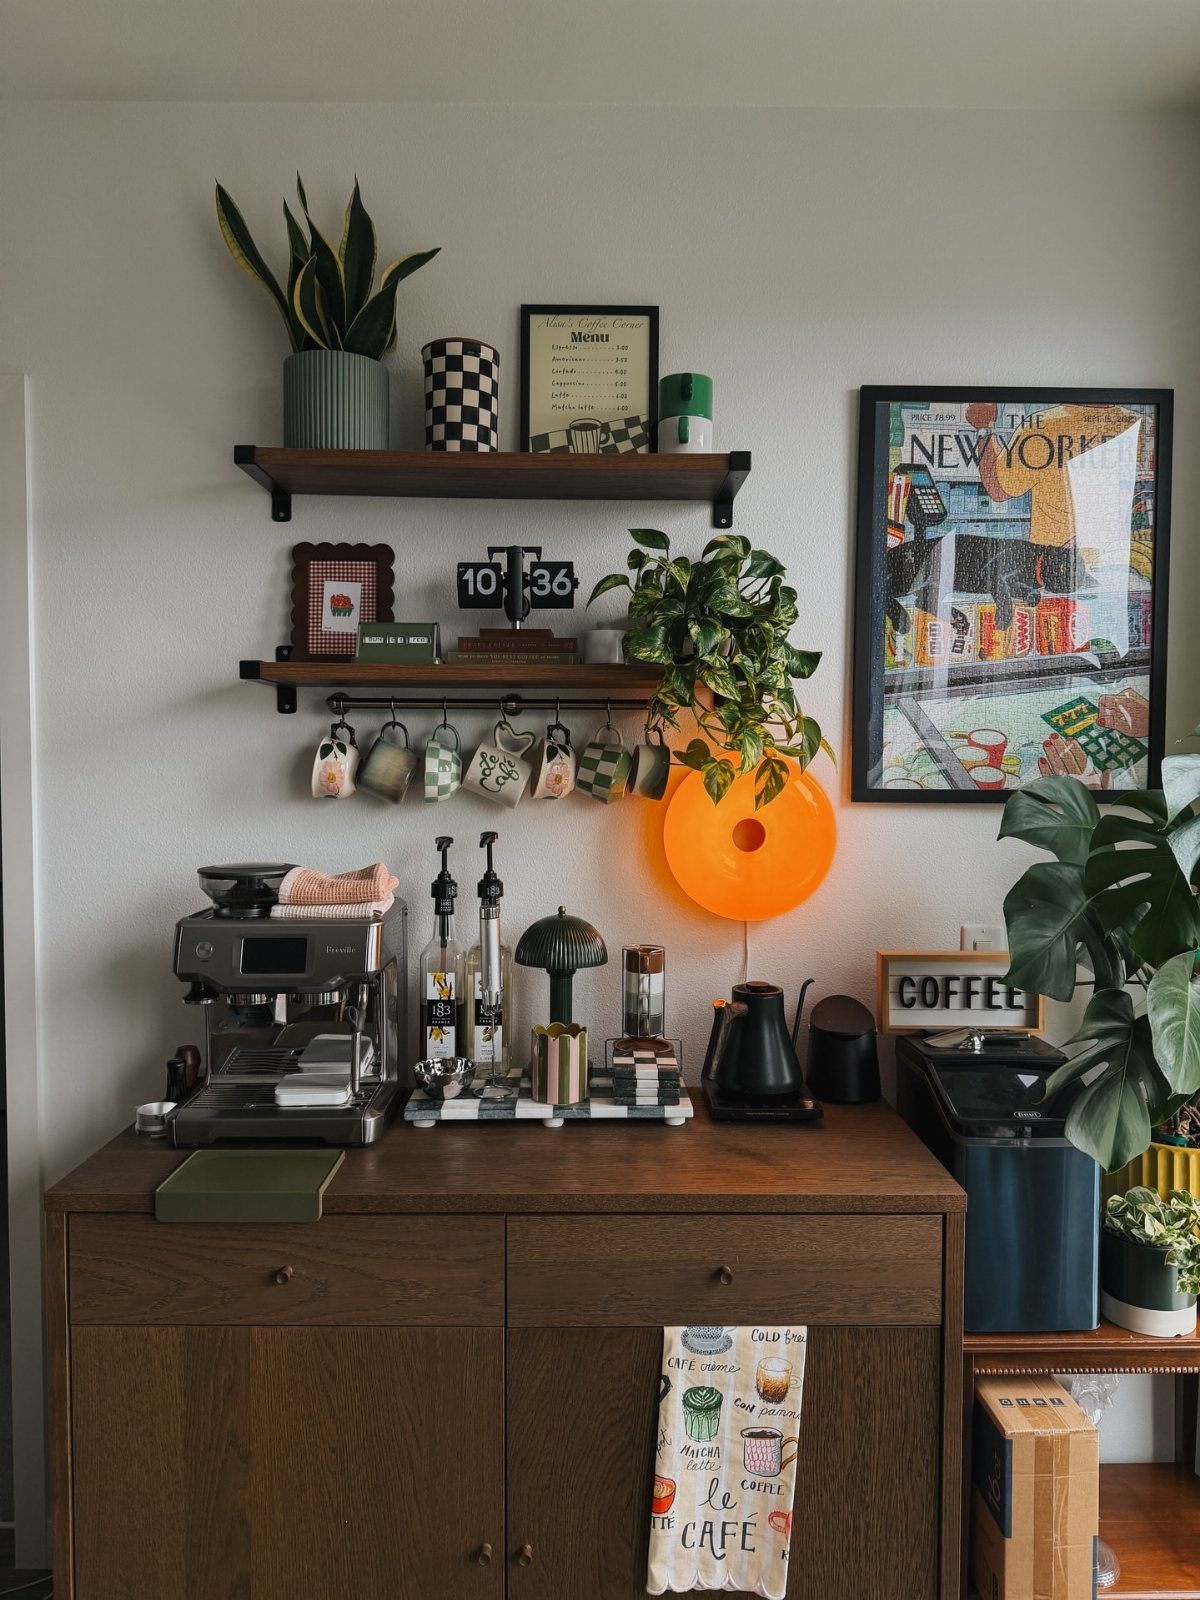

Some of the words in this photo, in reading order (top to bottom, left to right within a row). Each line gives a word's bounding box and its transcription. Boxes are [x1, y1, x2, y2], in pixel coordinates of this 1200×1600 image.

[537, 314, 573, 329] Alisa's
[578, 316, 608, 332] Coffee
[612, 318, 644, 329] Corner
[570, 332, 610, 342] Menu
[911, 414, 932, 422] PRICE
[1007, 414, 1044, 430] THE
[910, 433, 990, 469] NEW
[998, 433, 1134, 470] YORKER
[462, 568, 496, 596] 10
[532, 568, 572, 596] 36
[479, 751, 500, 777] Le
[479, 756, 520, 792] Café
[326, 944, 356, 954] Breville
[899, 976, 1024, 1010] COFFEE
[751, 1328, 780, 1342] COLD
[666, 1356, 697, 1372] CAFÉ
[700, 1358, 741, 1373] crème
[733, 1398, 756, 1414] CON
[758, 1406, 802, 1420] pann
[680, 1445, 721, 1459] MATCHA
[686, 1459, 722, 1472] latte
[698, 1477, 738, 1511] le
[740, 1479, 785, 1496] COFFEE
[681, 1512, 758, 1561] CAFÉ
